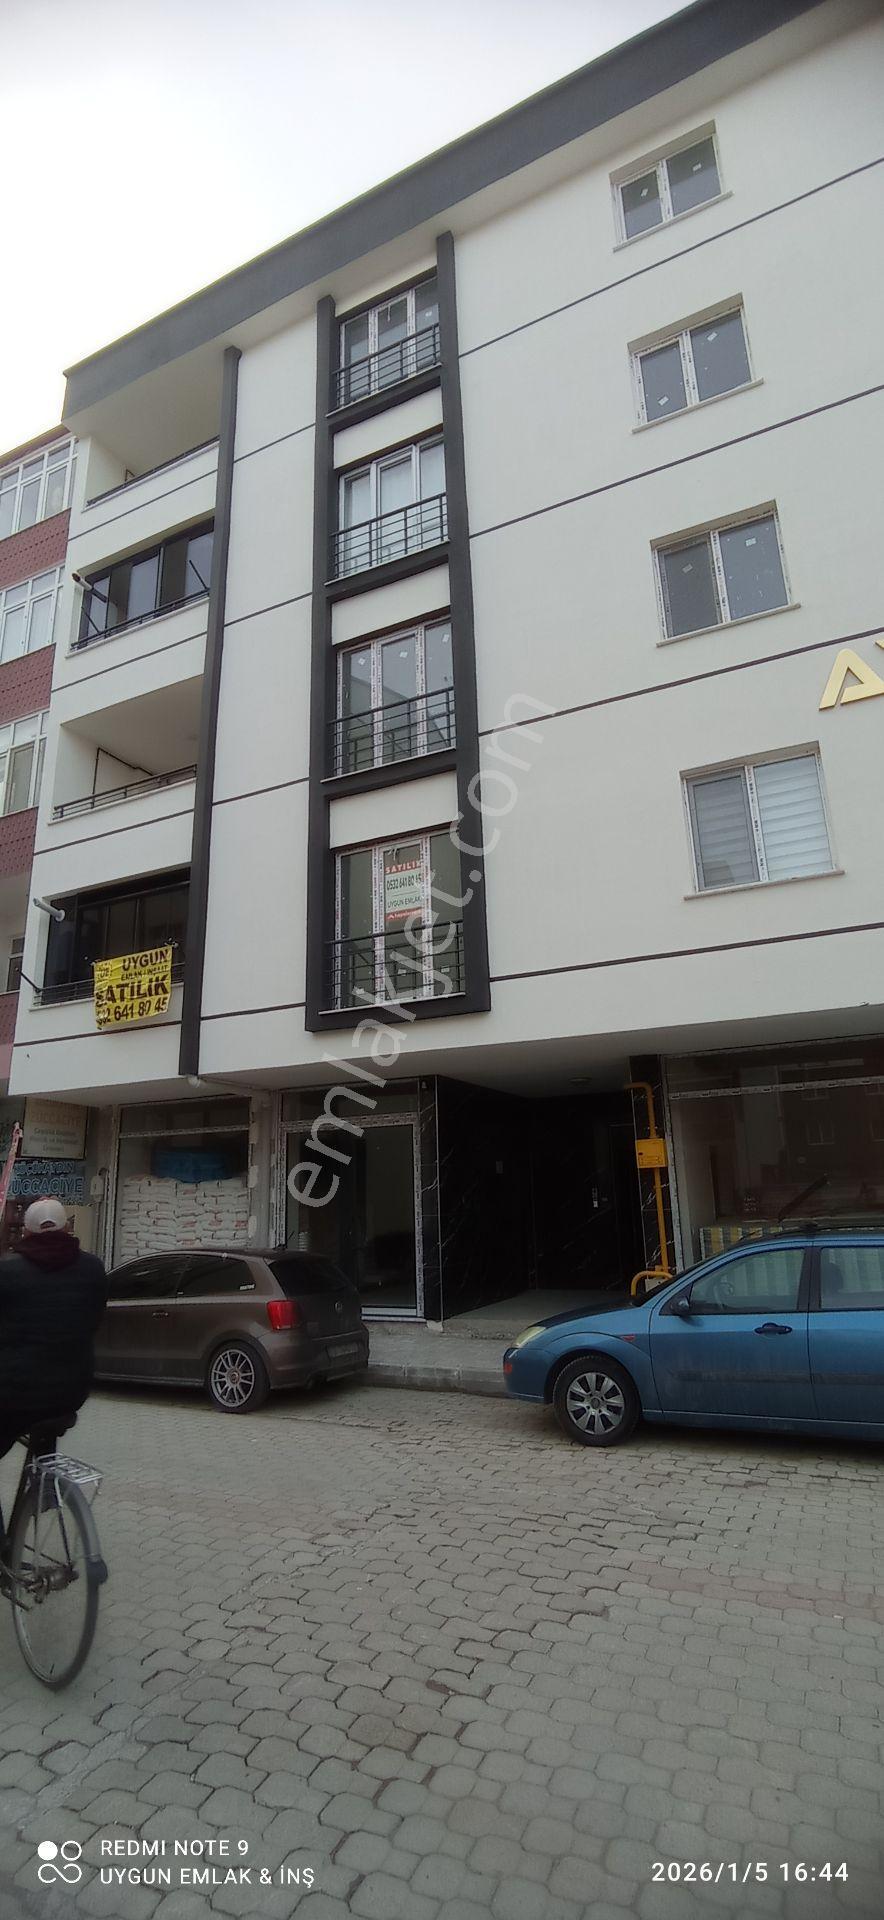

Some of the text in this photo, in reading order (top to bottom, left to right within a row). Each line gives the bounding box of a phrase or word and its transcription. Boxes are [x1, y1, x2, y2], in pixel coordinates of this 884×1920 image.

[819, 638, 884, 710] A
[122, 949, 168, 971] UYGUN
[114, 1003, 134, 1021] 641
[138, 999, 152, 1017] 80
[155, 997, 168, 1012] 45
